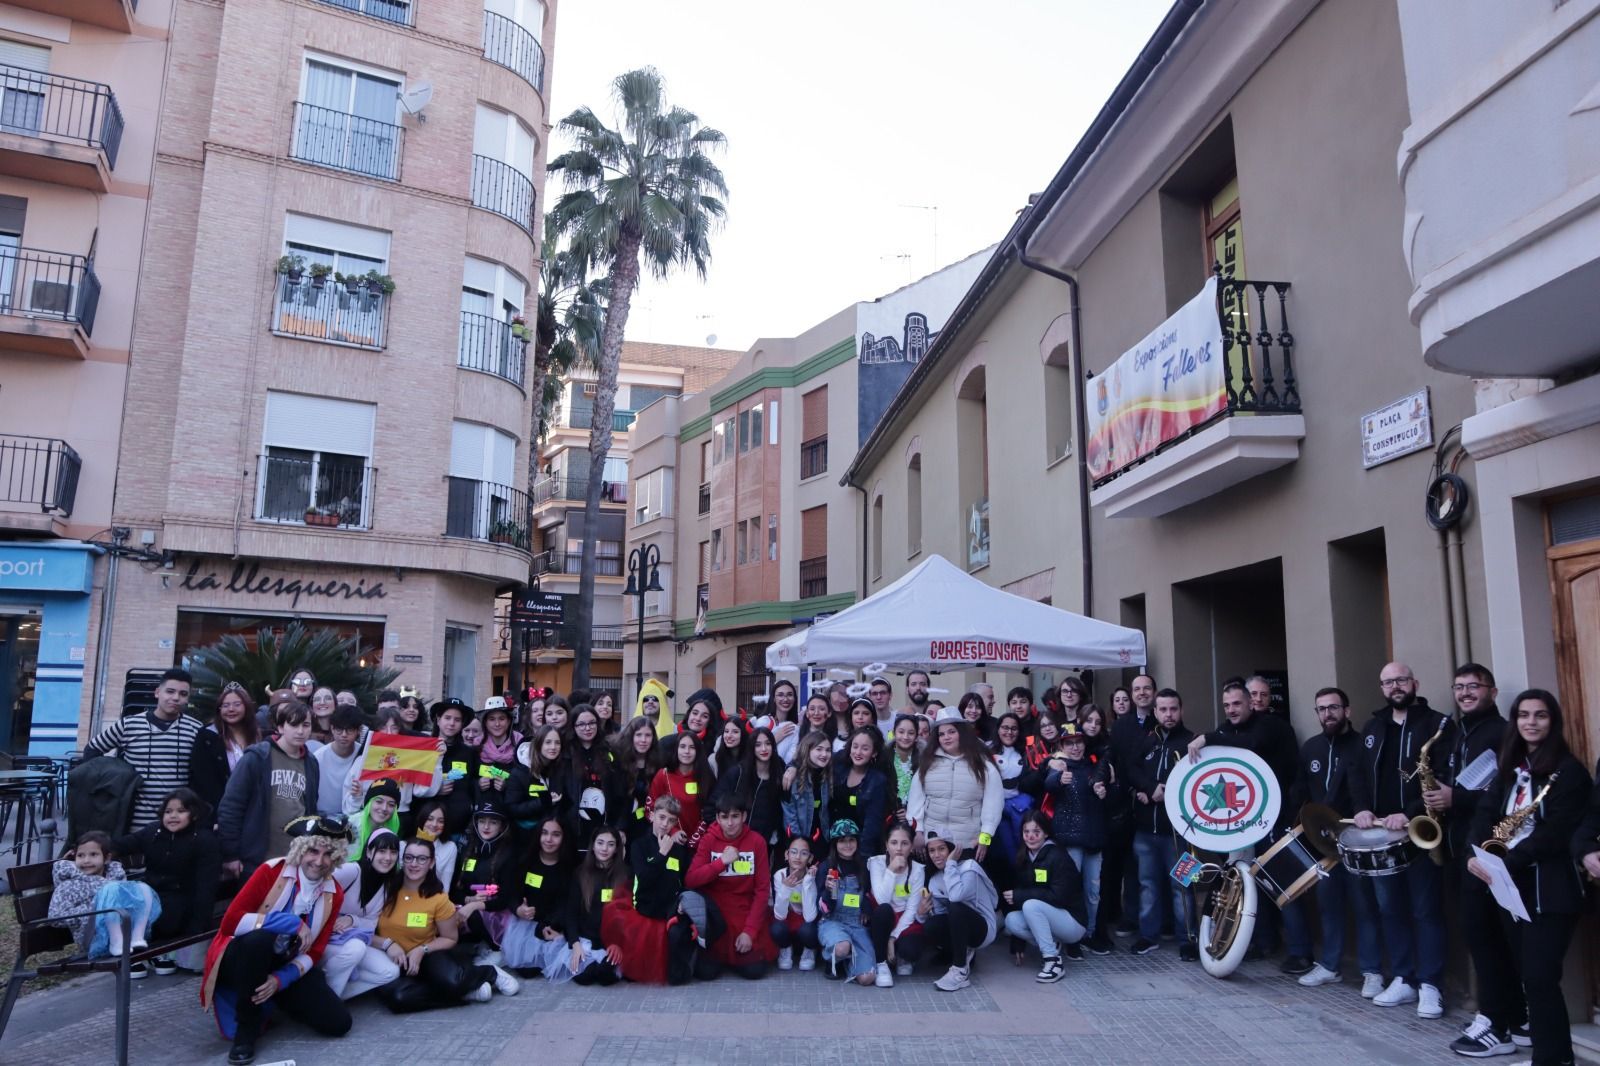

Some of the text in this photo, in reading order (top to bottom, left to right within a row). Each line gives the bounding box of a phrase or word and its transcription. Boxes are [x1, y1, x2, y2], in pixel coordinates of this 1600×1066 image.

[1379, 411, 1402, 428] PLAÇA
[1372, 424, 1418, 452] CONSTITUCIÓ
[179, 559, 221, 591] la
[1203, 782, 1245, 810] XL
